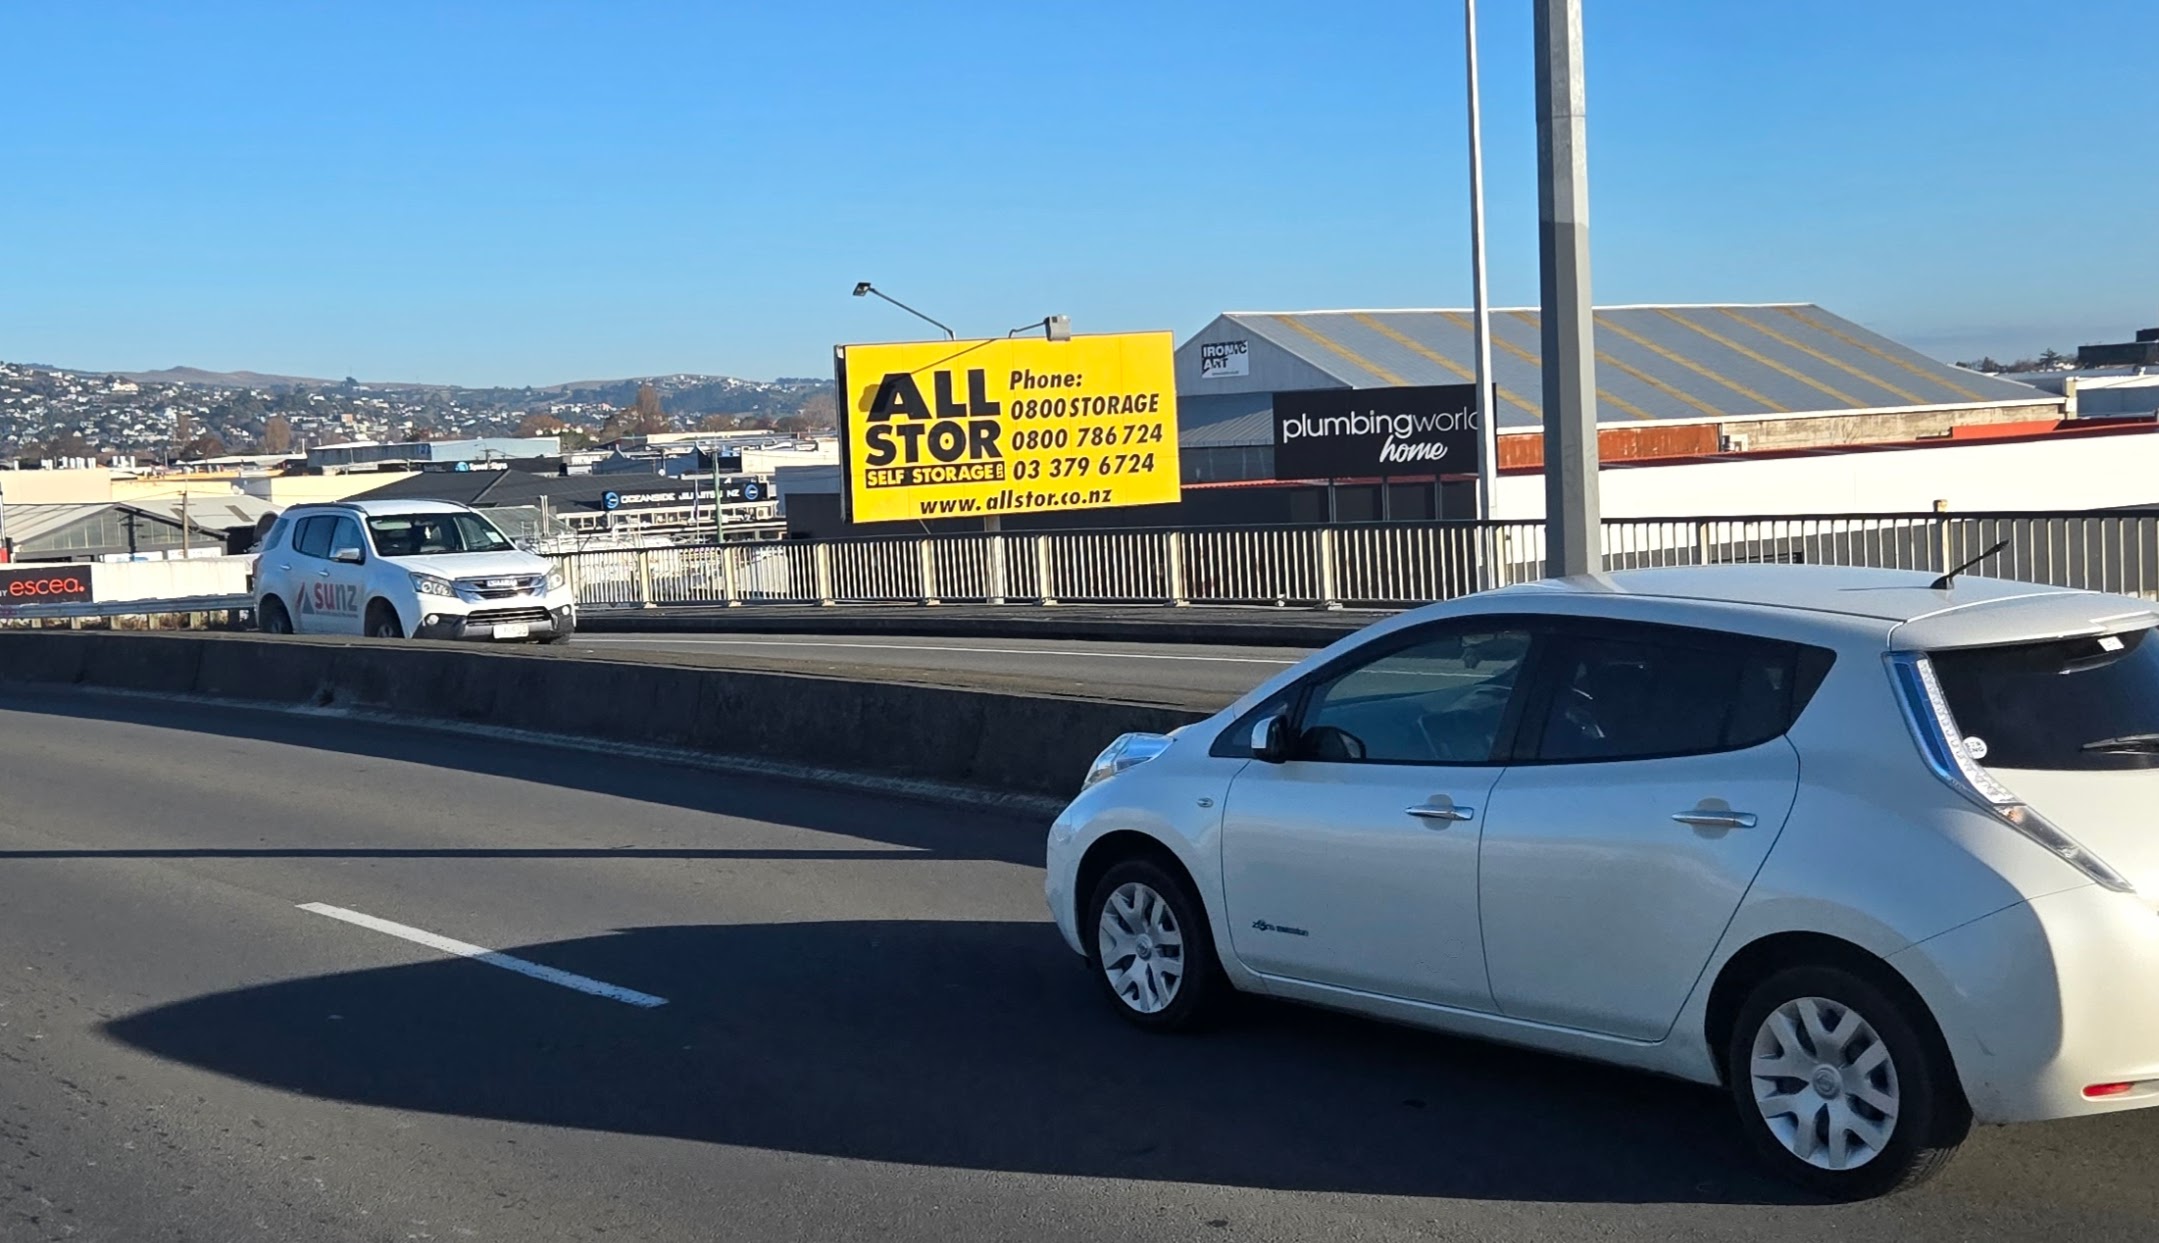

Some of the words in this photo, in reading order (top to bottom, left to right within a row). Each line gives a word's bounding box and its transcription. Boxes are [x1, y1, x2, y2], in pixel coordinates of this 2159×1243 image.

[1203, 357, 1228, 370] ART
[1010, 369, 1083, 391] Phone:
[866, 369, 1001, 422] ALL
[865, 420, 1004, 467] STOR
[1012, 428, 1068, 451] 0800
[1076, 426, 1117, 448] 786
[1122, 424, 1163, 446] 724
[1380, 434, 1448, 463] home
[867, 469, 905, 487] SELF
[912, 464, 994, 484] STORAGE
[1013, 460, 1041, 481] 03
[1049, 457, 1090, 479] 379
[1099, 453, 1155, 476] 6724
[726, 489, 740, 498] NZ
[314, 582, 358, 612] sunz
